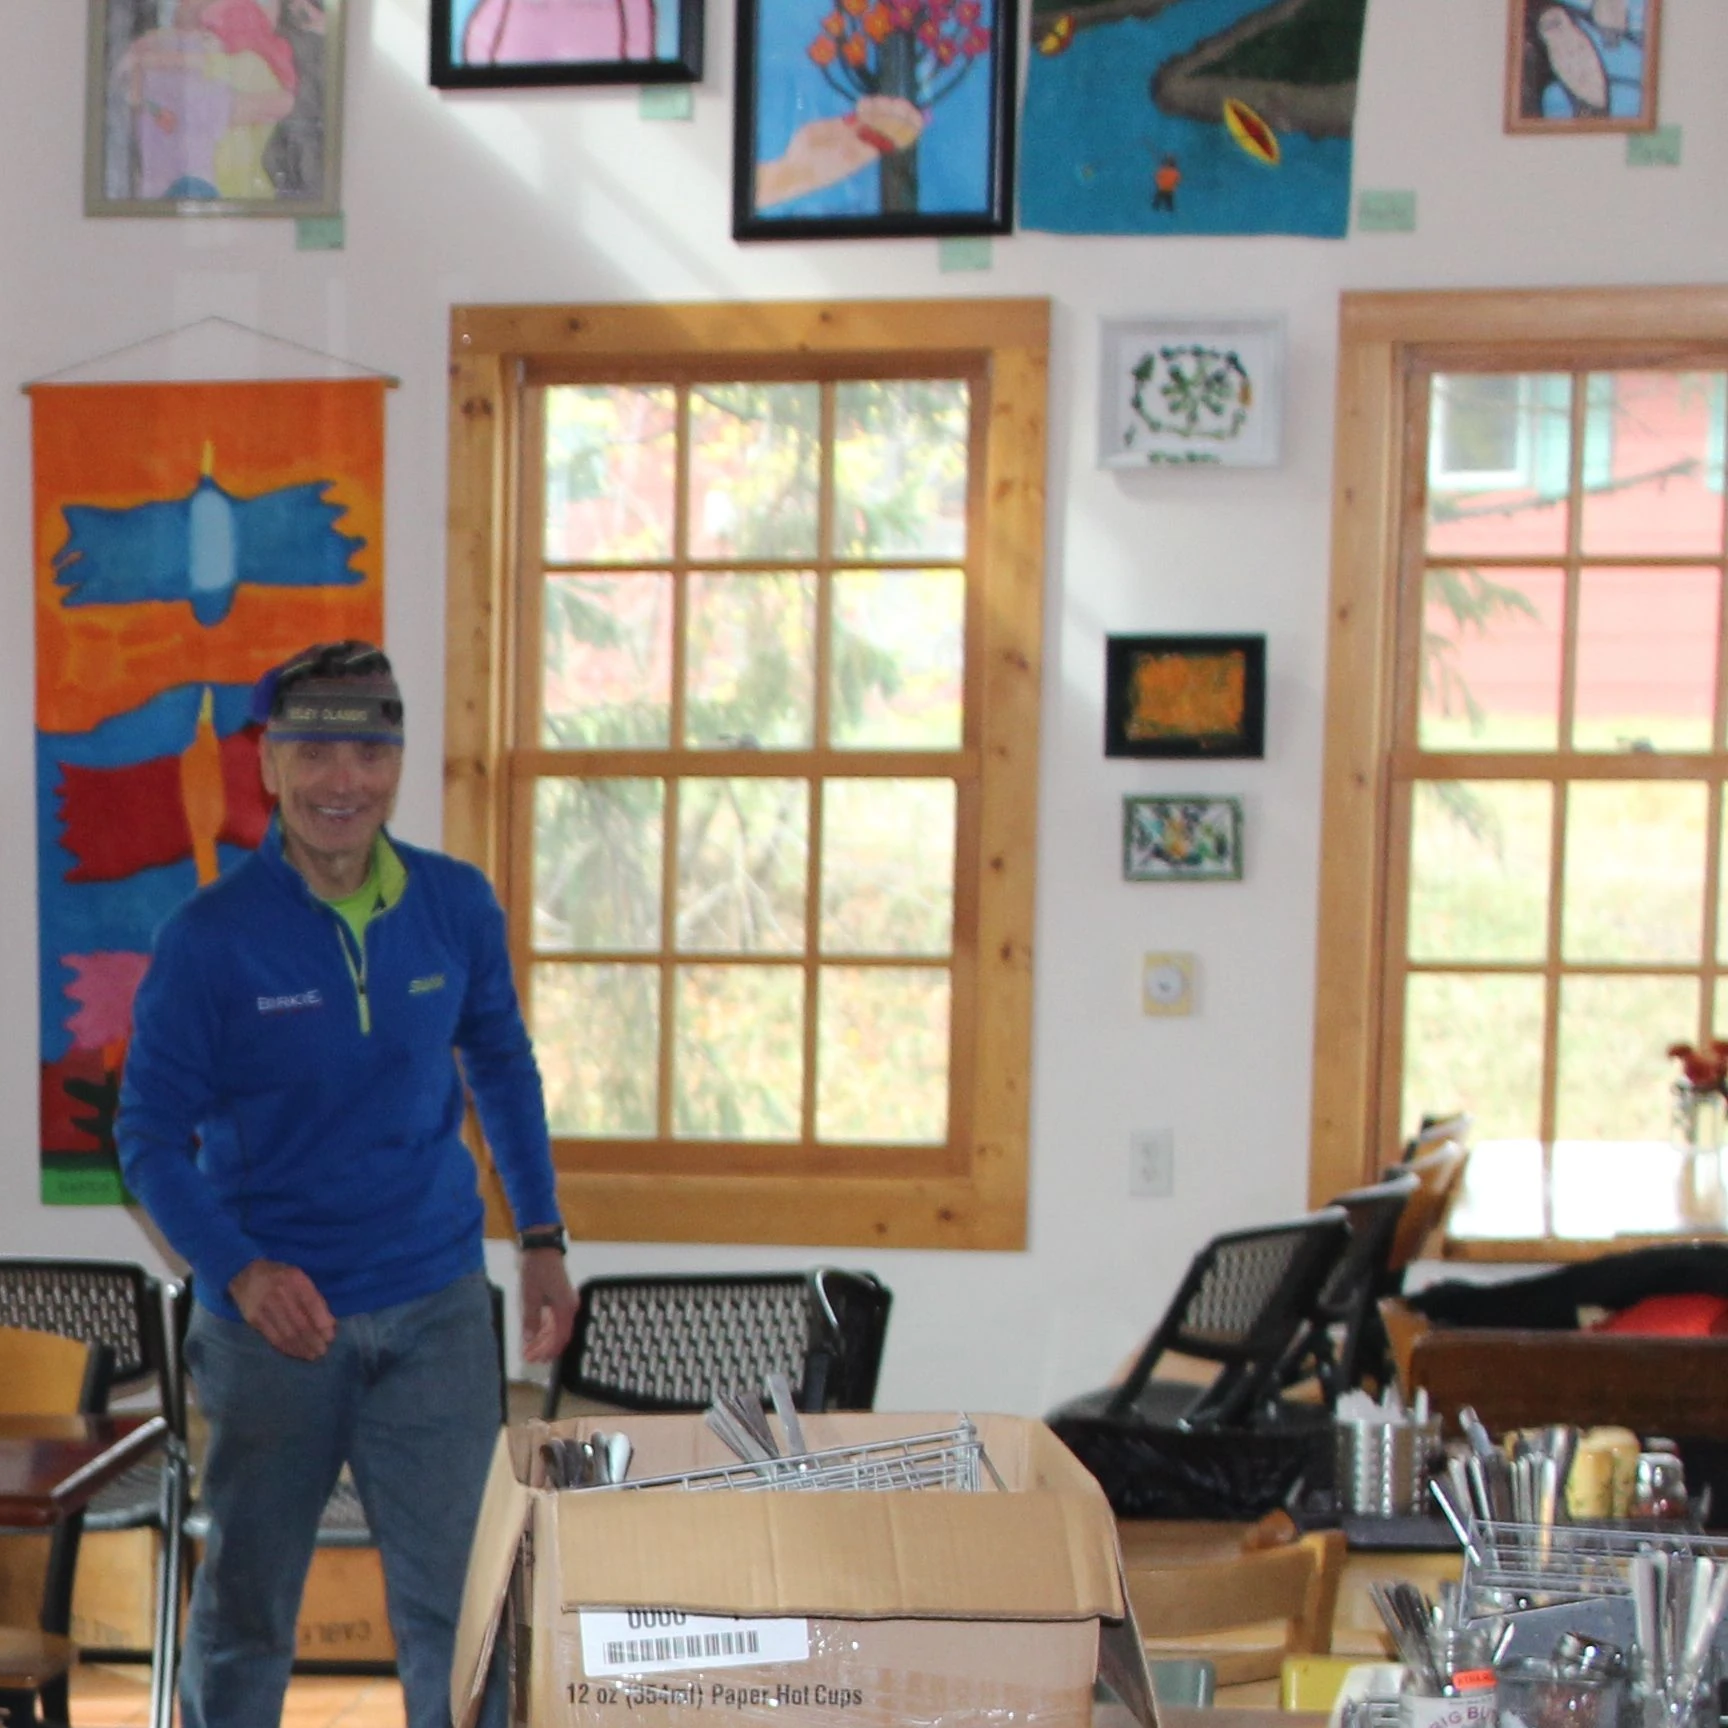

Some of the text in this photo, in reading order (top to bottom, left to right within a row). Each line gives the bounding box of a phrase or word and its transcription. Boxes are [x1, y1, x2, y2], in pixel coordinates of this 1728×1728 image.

[566, 1684, 589, 1705] 12
[596, 1688, 618, 1705] oz
[711, 1684, 770, 1710] Paper
[775, 1684, 811, 1706] Hot
[814, 1684, 864, 1709] Cups
